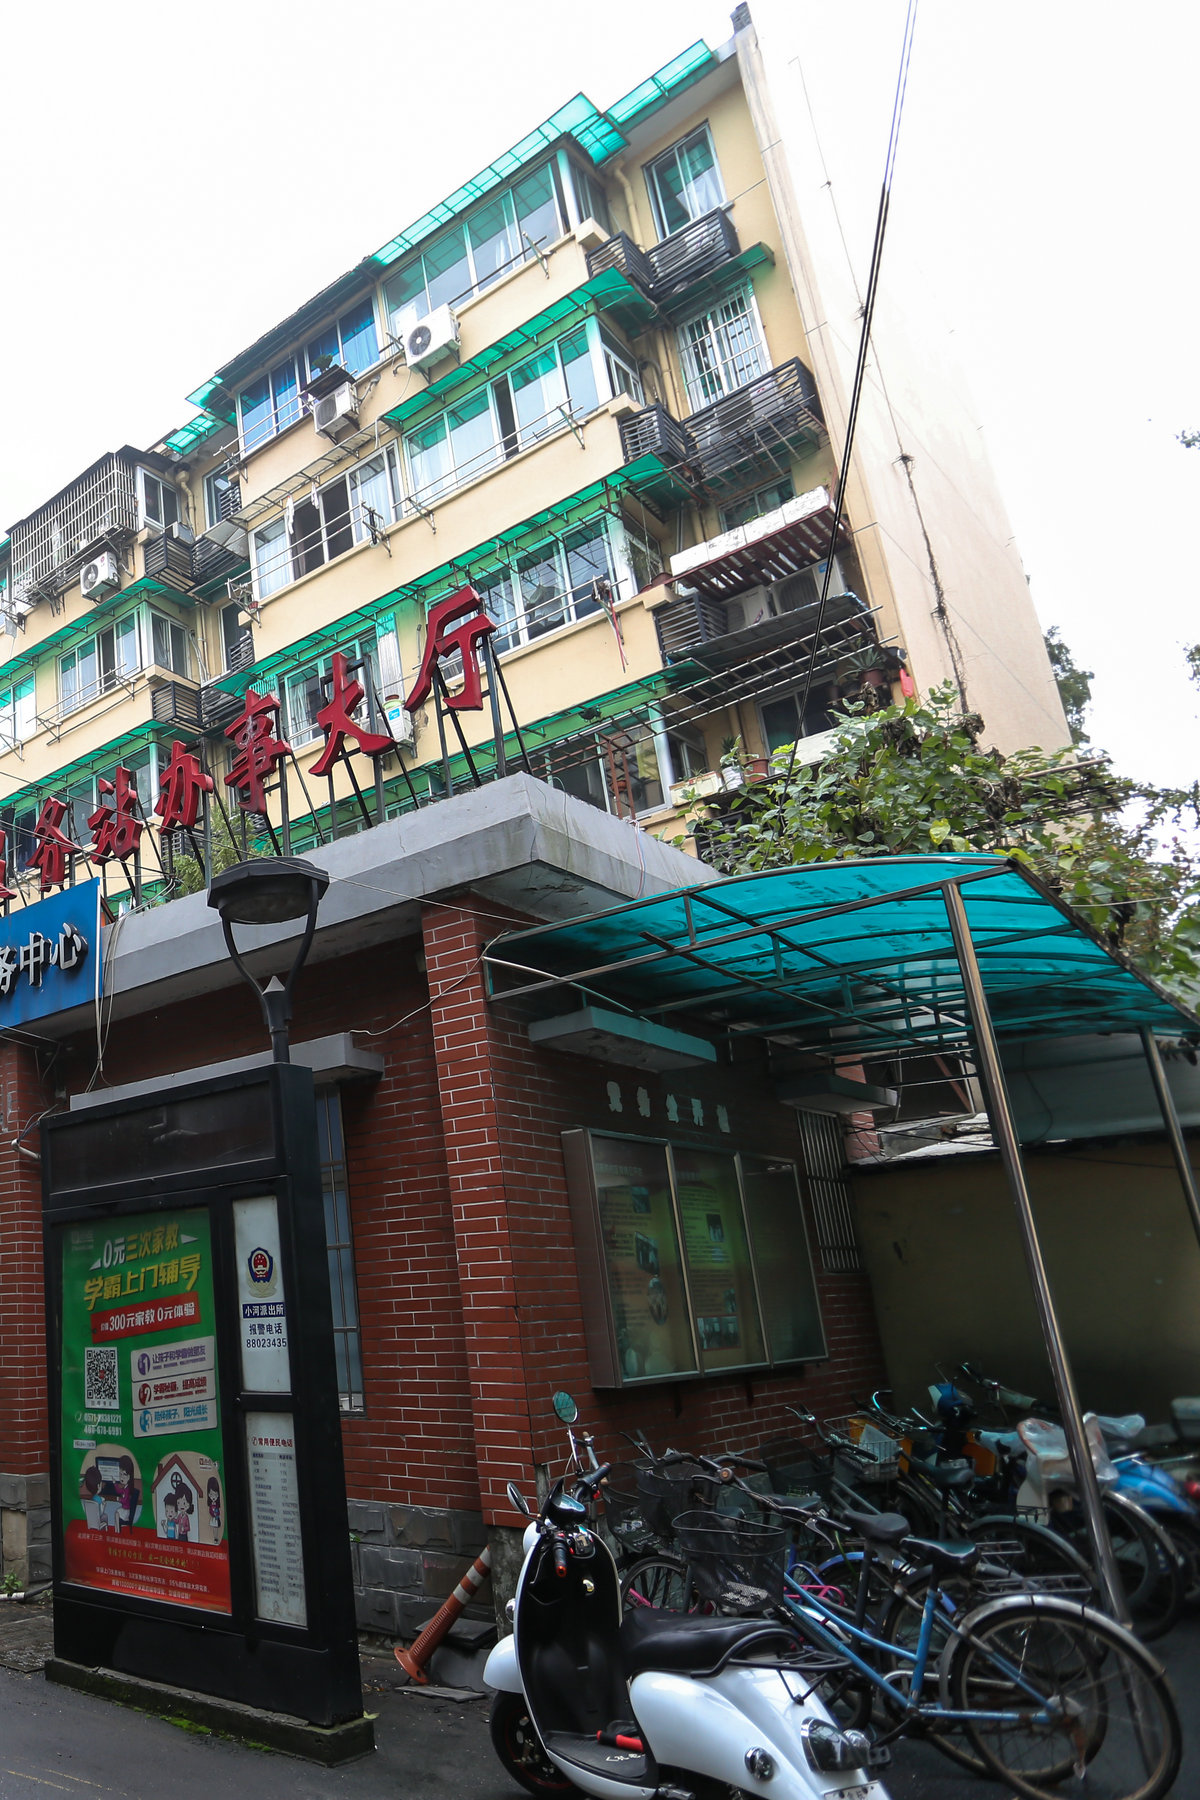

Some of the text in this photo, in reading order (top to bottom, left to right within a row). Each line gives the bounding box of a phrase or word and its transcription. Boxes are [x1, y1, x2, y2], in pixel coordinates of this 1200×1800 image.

[103, 1222, 180, 1269] 0元三次家教
[83, 1253, 202, 1311] 学霸上门辅导
[157, 1302, 196, 1322] 0元体验
[244, 1304, 285, 1316] 小河派出所
[248, 1323, 283, 1335] 报警电话
[246, 1338, 288, 1349] 88023435
